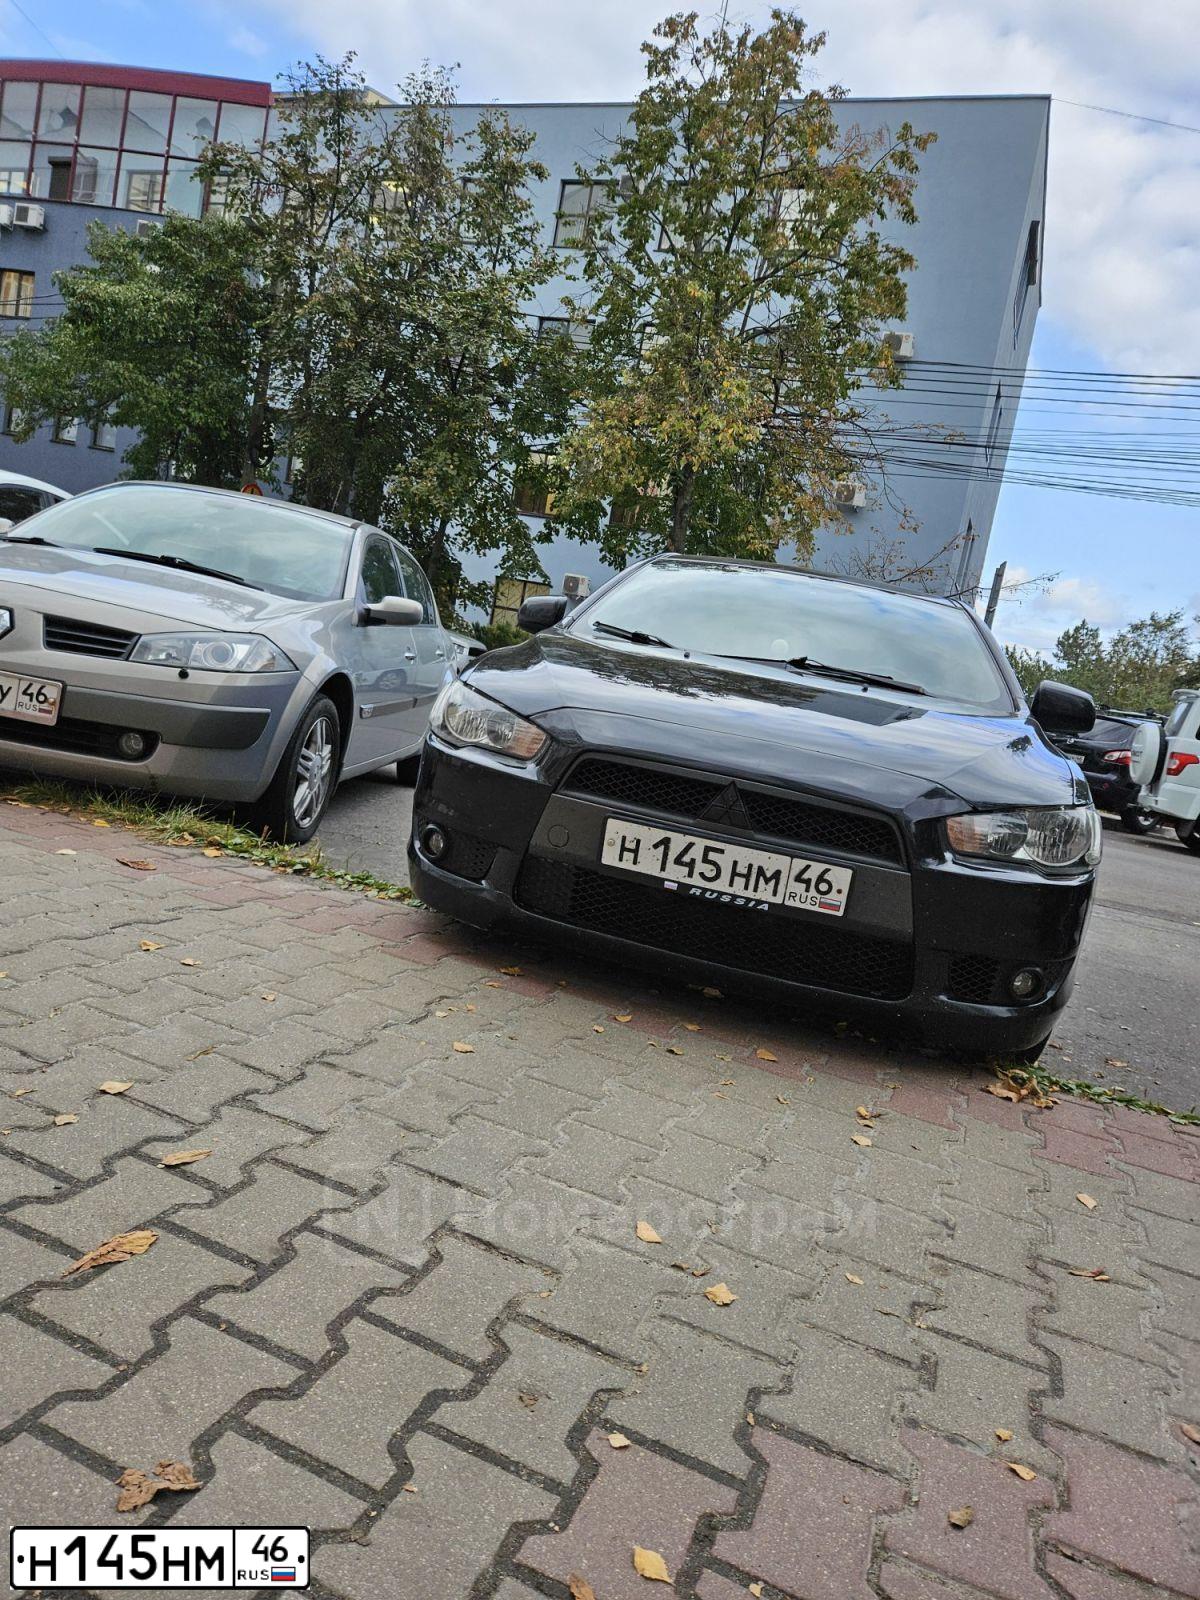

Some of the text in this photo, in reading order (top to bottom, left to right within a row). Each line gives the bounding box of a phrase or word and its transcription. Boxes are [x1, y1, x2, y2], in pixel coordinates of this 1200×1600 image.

[22, 683, 47, 704] 46
[17, 701, 38, 712] RUS
[794, 864, 833, 896] 46
[689, 887, 769, 911] RUSSIA
[788, 891, 818, 907] RUS
